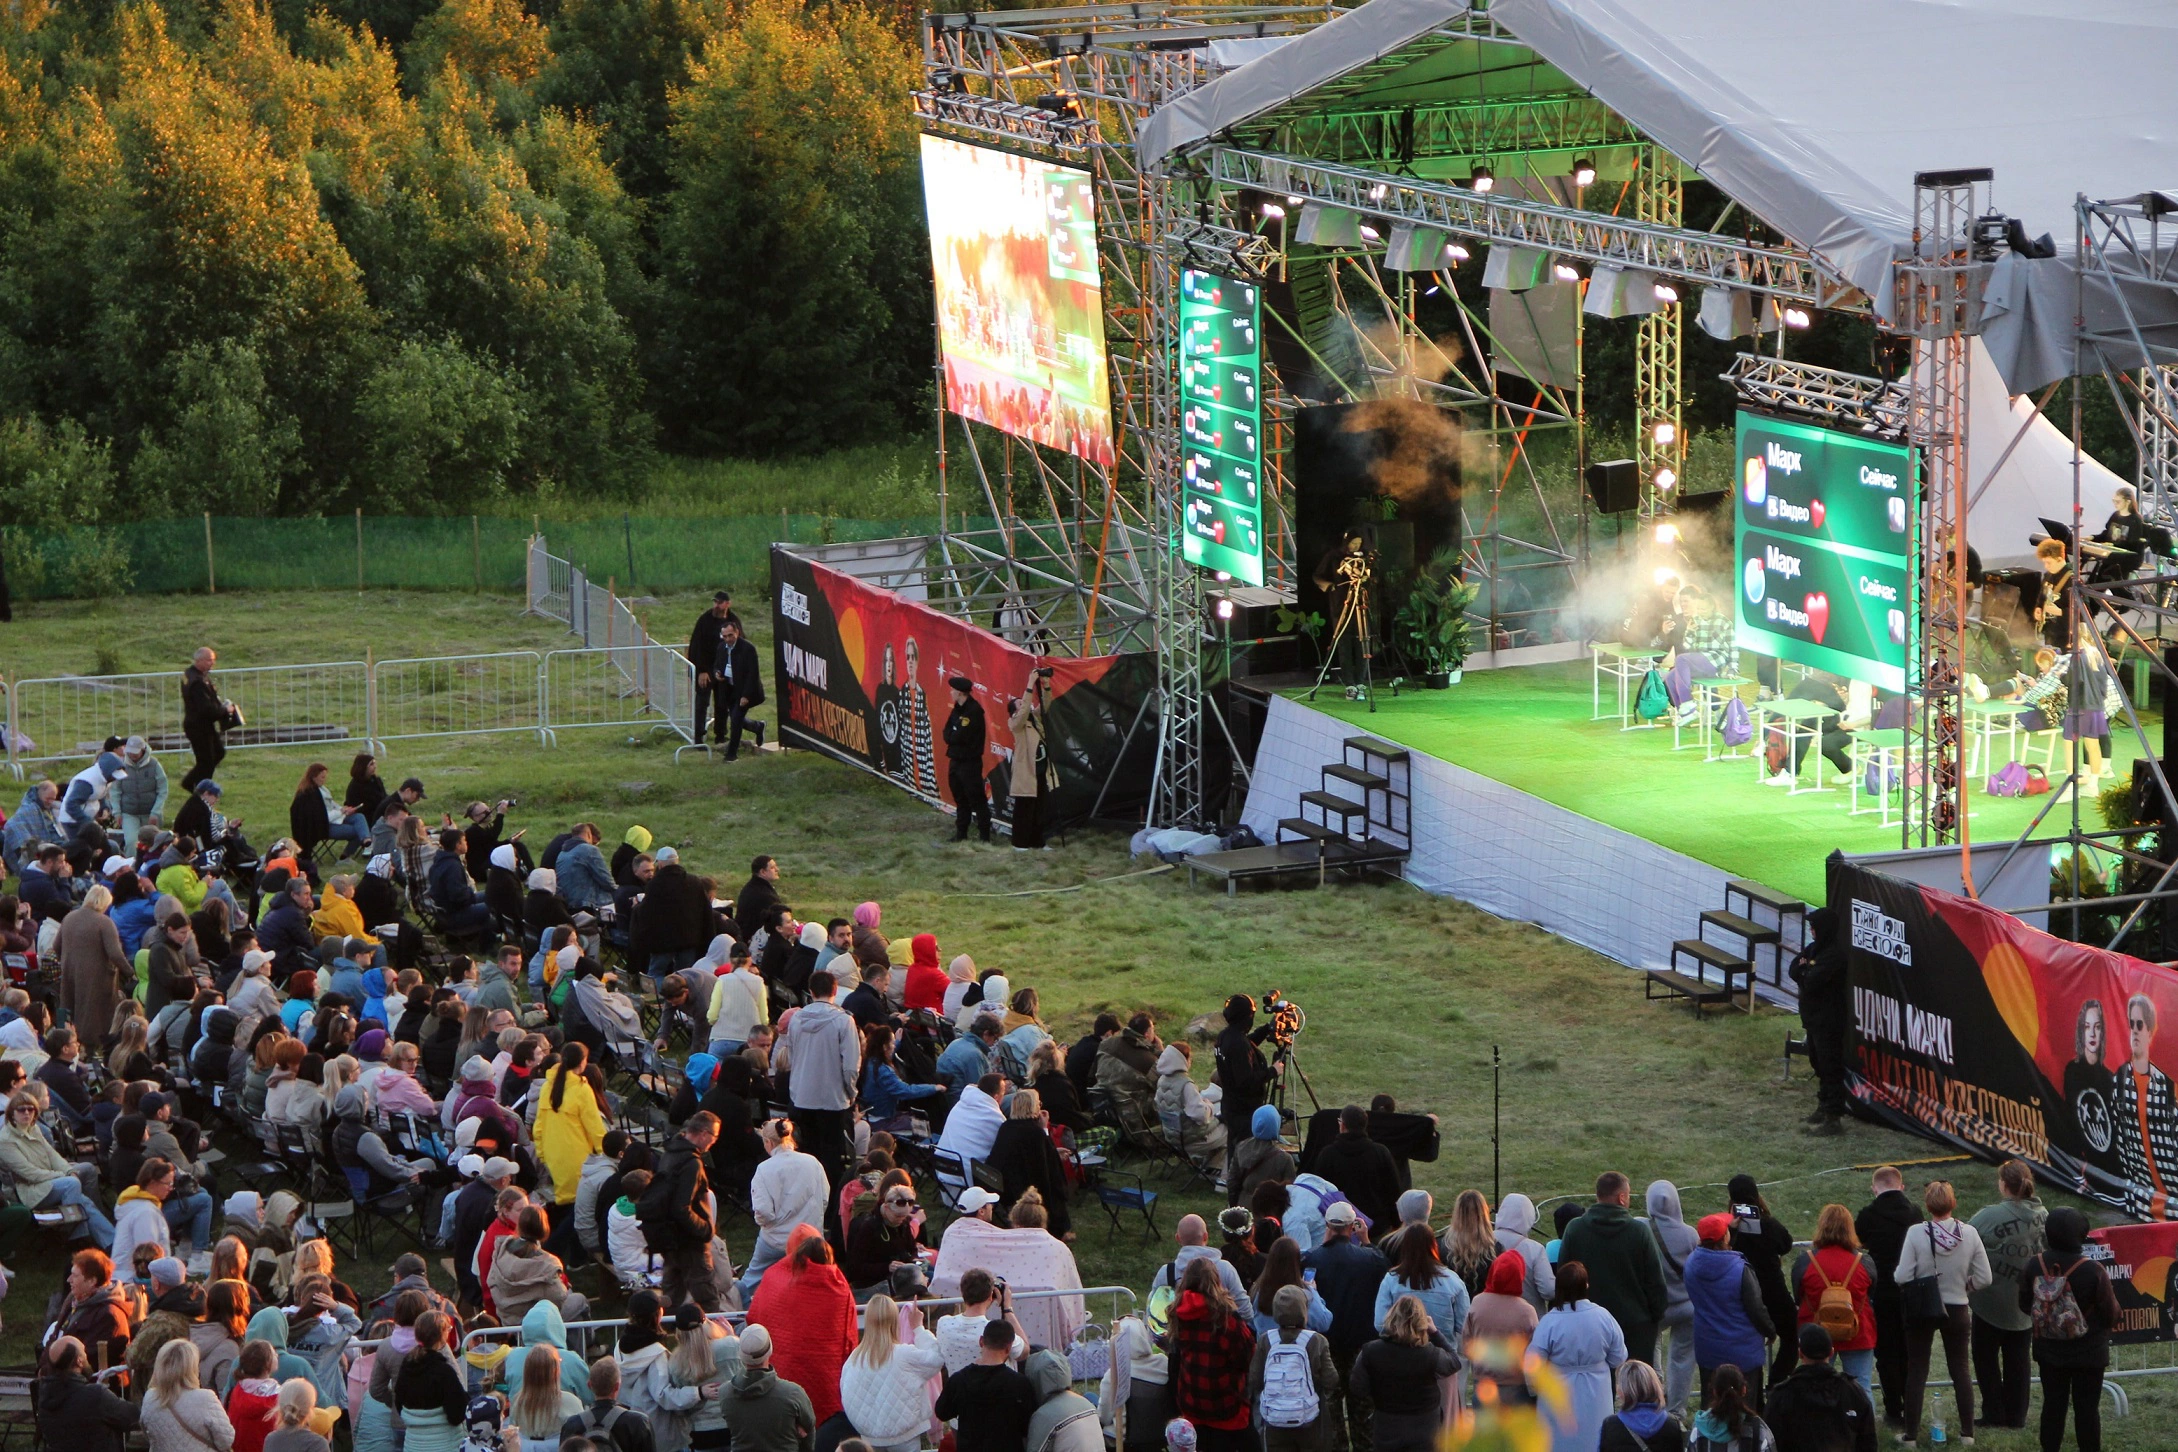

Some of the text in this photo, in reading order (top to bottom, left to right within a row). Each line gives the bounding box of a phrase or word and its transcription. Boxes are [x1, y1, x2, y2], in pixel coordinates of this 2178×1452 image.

[1767, 441, 1802, 476] Марк
[1860, 465, 1898, 490] Сейчас
[1779, 499, 1810, 522] Видео
[1767, 545, 1801, 580] Марк
[1859, 575, 1897, 601] Сейчас
[1779, 601, 1809, 627] Видео
[1853, 986, 1954, 1065] УДАЧИ, МАРК!
[1994, 1218, 2020, 1239] GET
[2111, 1302, 2161, 1333] СТОВОЙ
